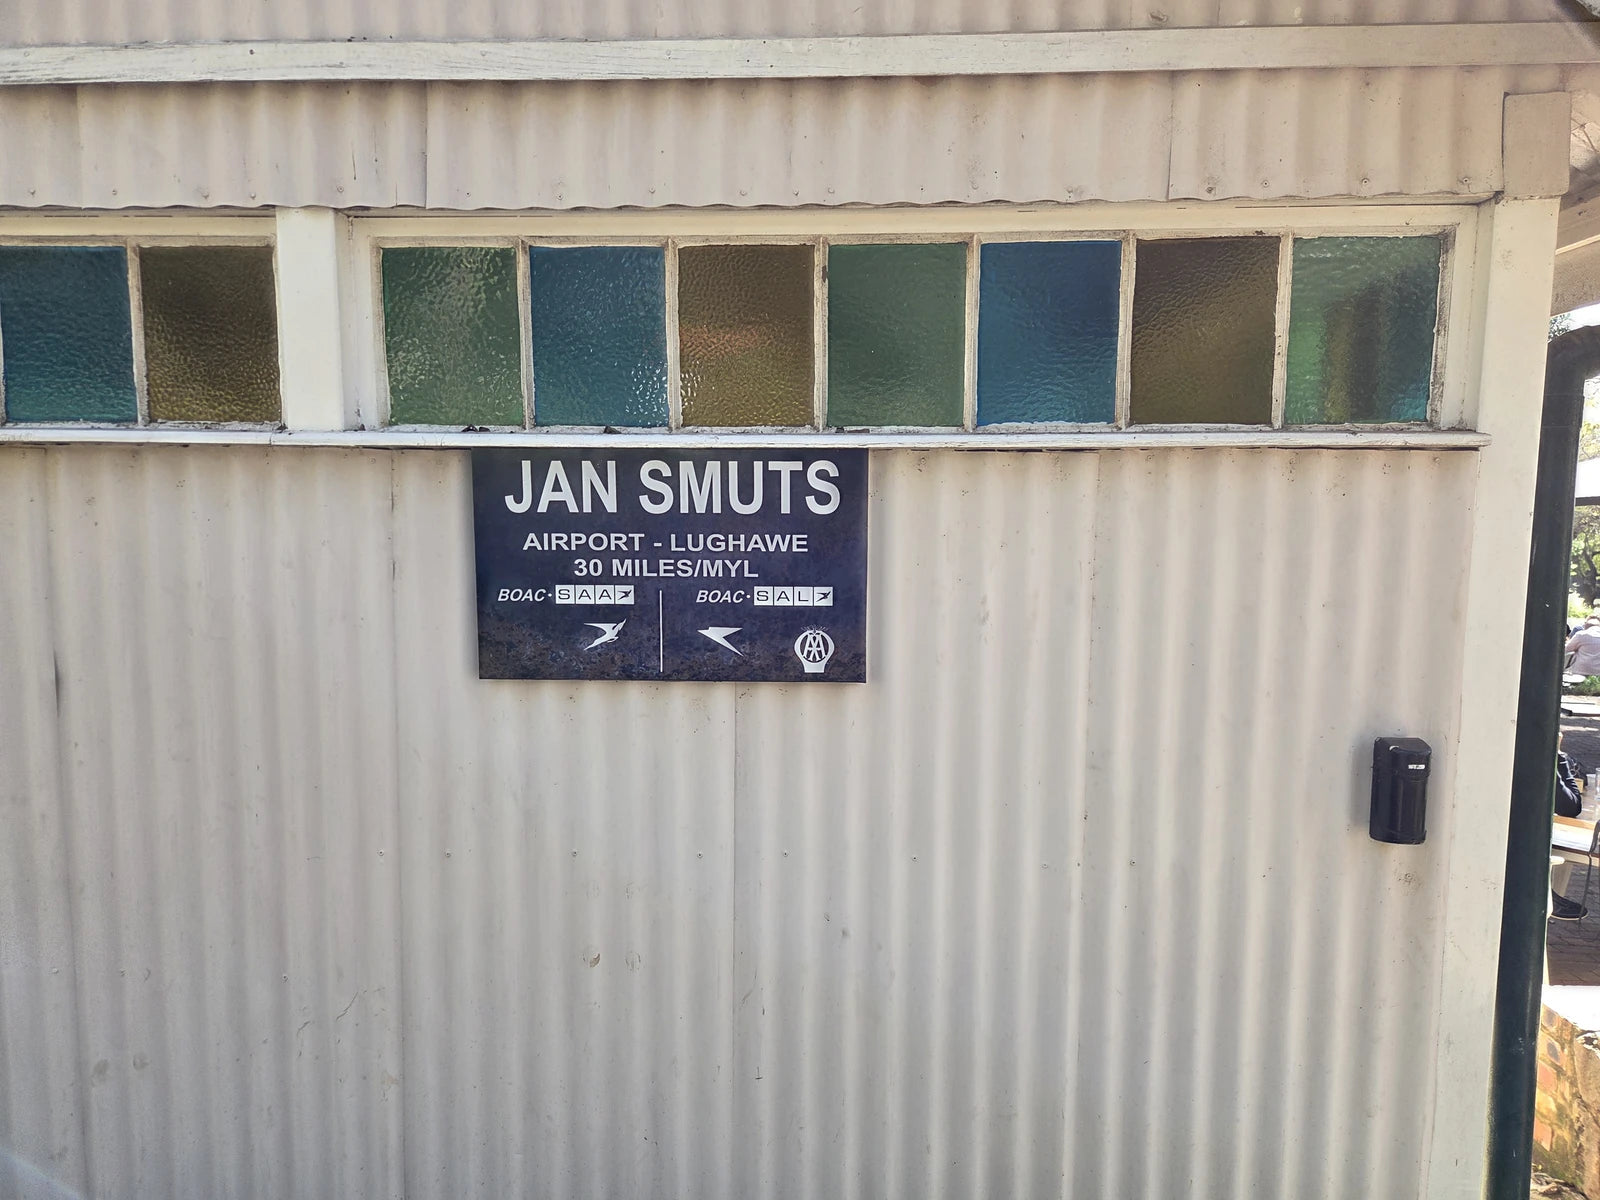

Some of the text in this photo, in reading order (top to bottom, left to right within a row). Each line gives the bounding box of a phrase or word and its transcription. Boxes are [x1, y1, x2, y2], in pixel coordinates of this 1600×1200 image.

[504, 459, 841, 515] JAN SMUTS
[522, 532, 645, 552] AIRPORT
[670, 533, 809, 553] LUGHAWE
[573, 558, 759, 578] 30 MILES/MYL
[557, 588, 613, 601] SAA
[756, 589, 809, 603] SAL
